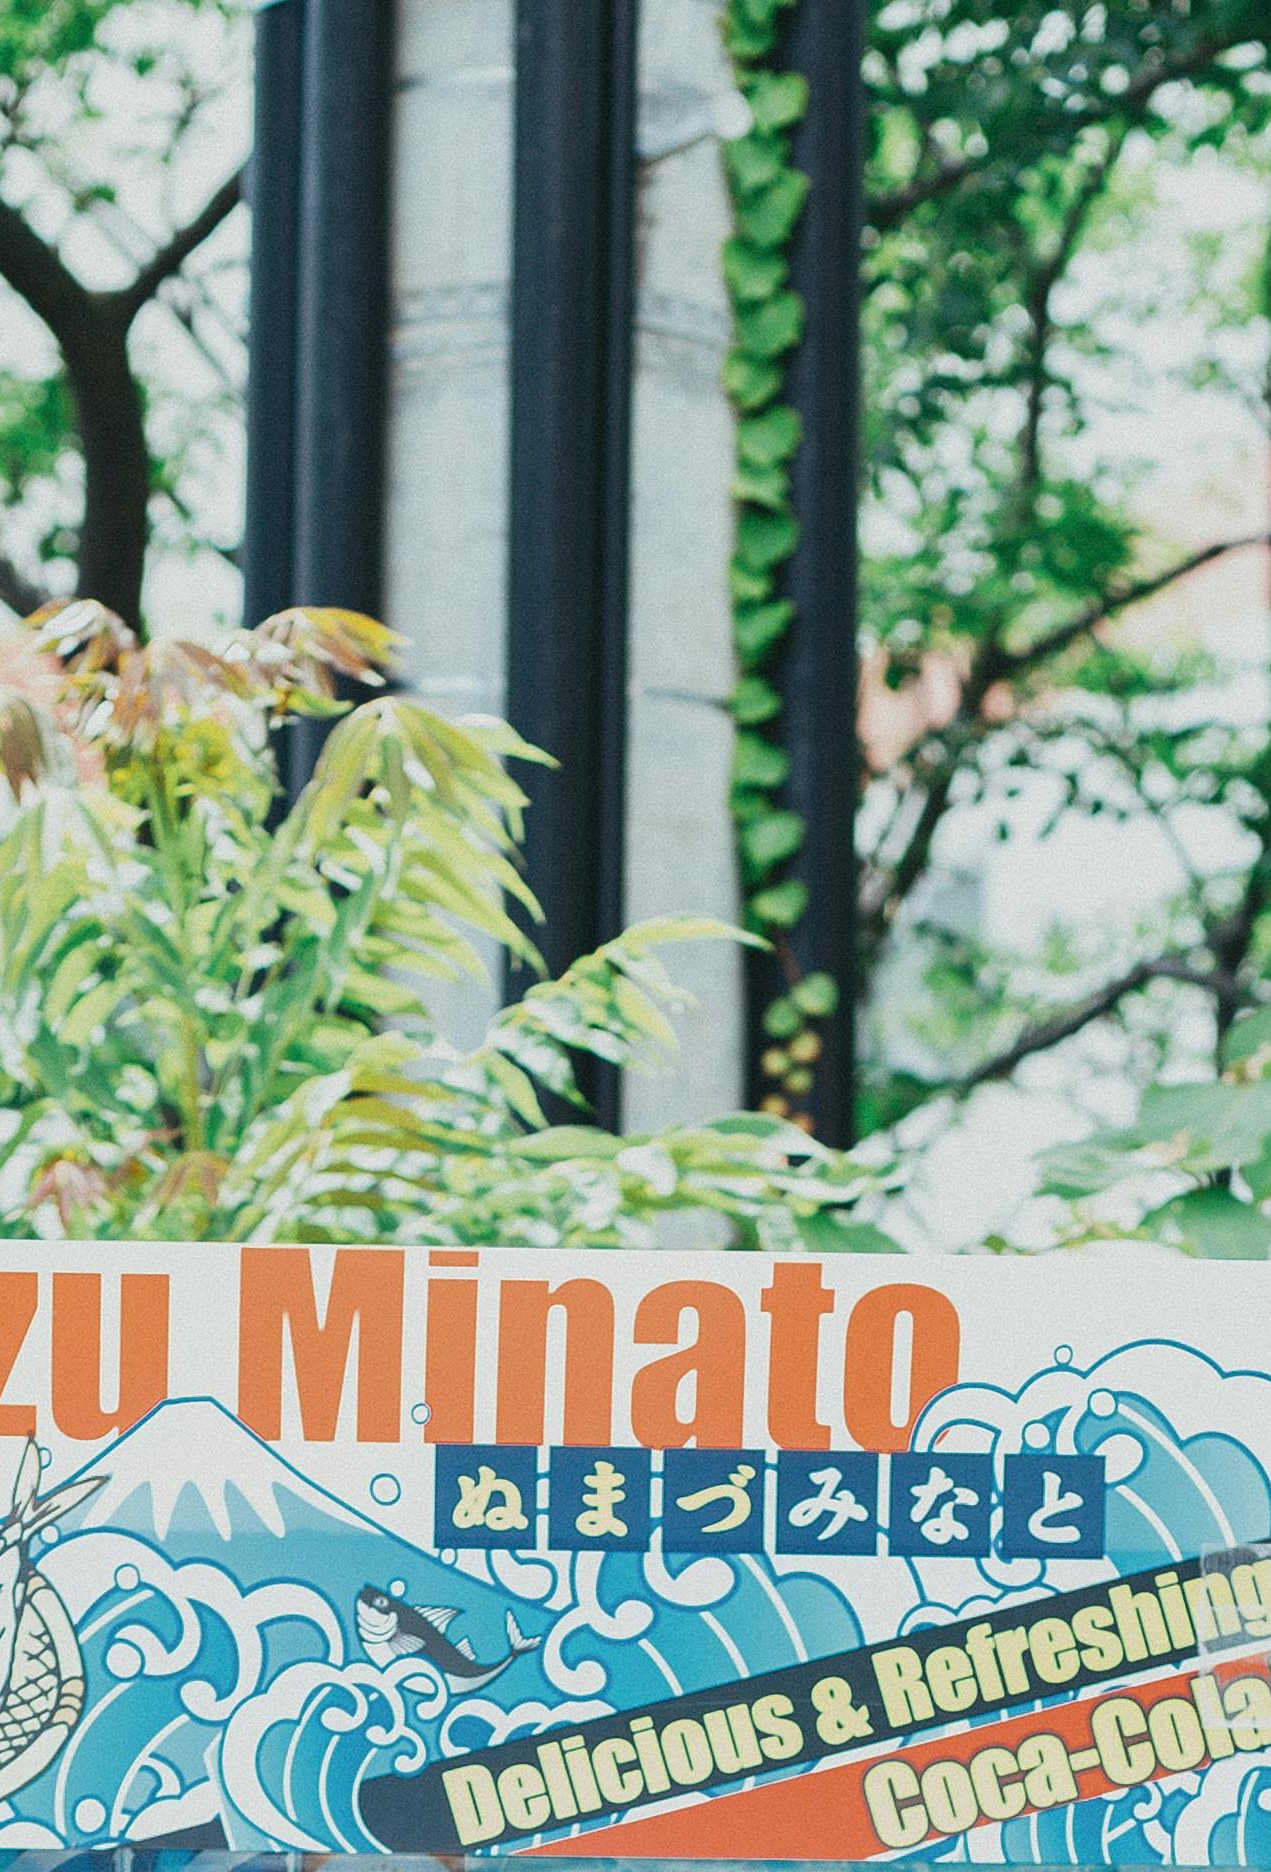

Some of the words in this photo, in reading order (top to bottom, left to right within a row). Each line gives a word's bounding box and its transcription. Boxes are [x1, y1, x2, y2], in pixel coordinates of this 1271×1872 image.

[238, 1247, 960, 1452] Minato
[452, 1464, 1086, 1544] ぬまづみなと
[441, 1690, 805, 1850] Delicious
[811, 1676, 872, 1751] &
